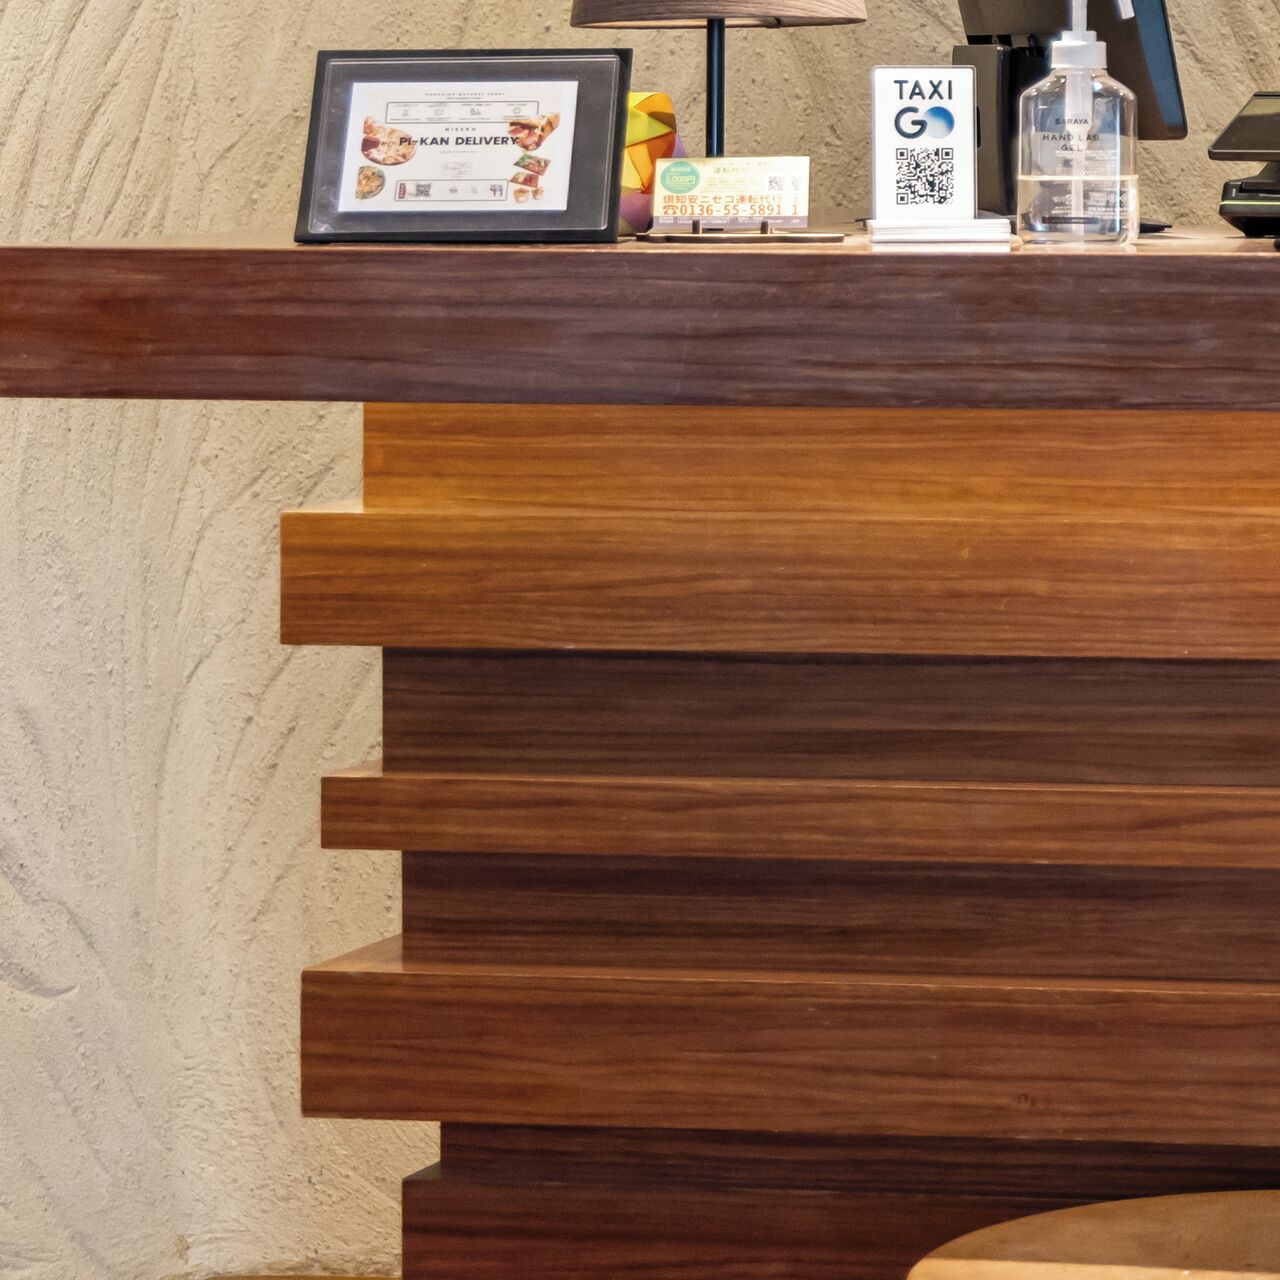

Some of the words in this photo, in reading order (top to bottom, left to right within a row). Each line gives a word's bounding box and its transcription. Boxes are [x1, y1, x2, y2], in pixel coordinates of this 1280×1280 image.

[893, 80, 953, 100] TAXI
[894, 106, 955, 139] GO
[455, 136, 520, 146] DELIVERY
[1042, 134, 1074, 142] HAND
[679, 204, 783, 215] 0136-55-5891
